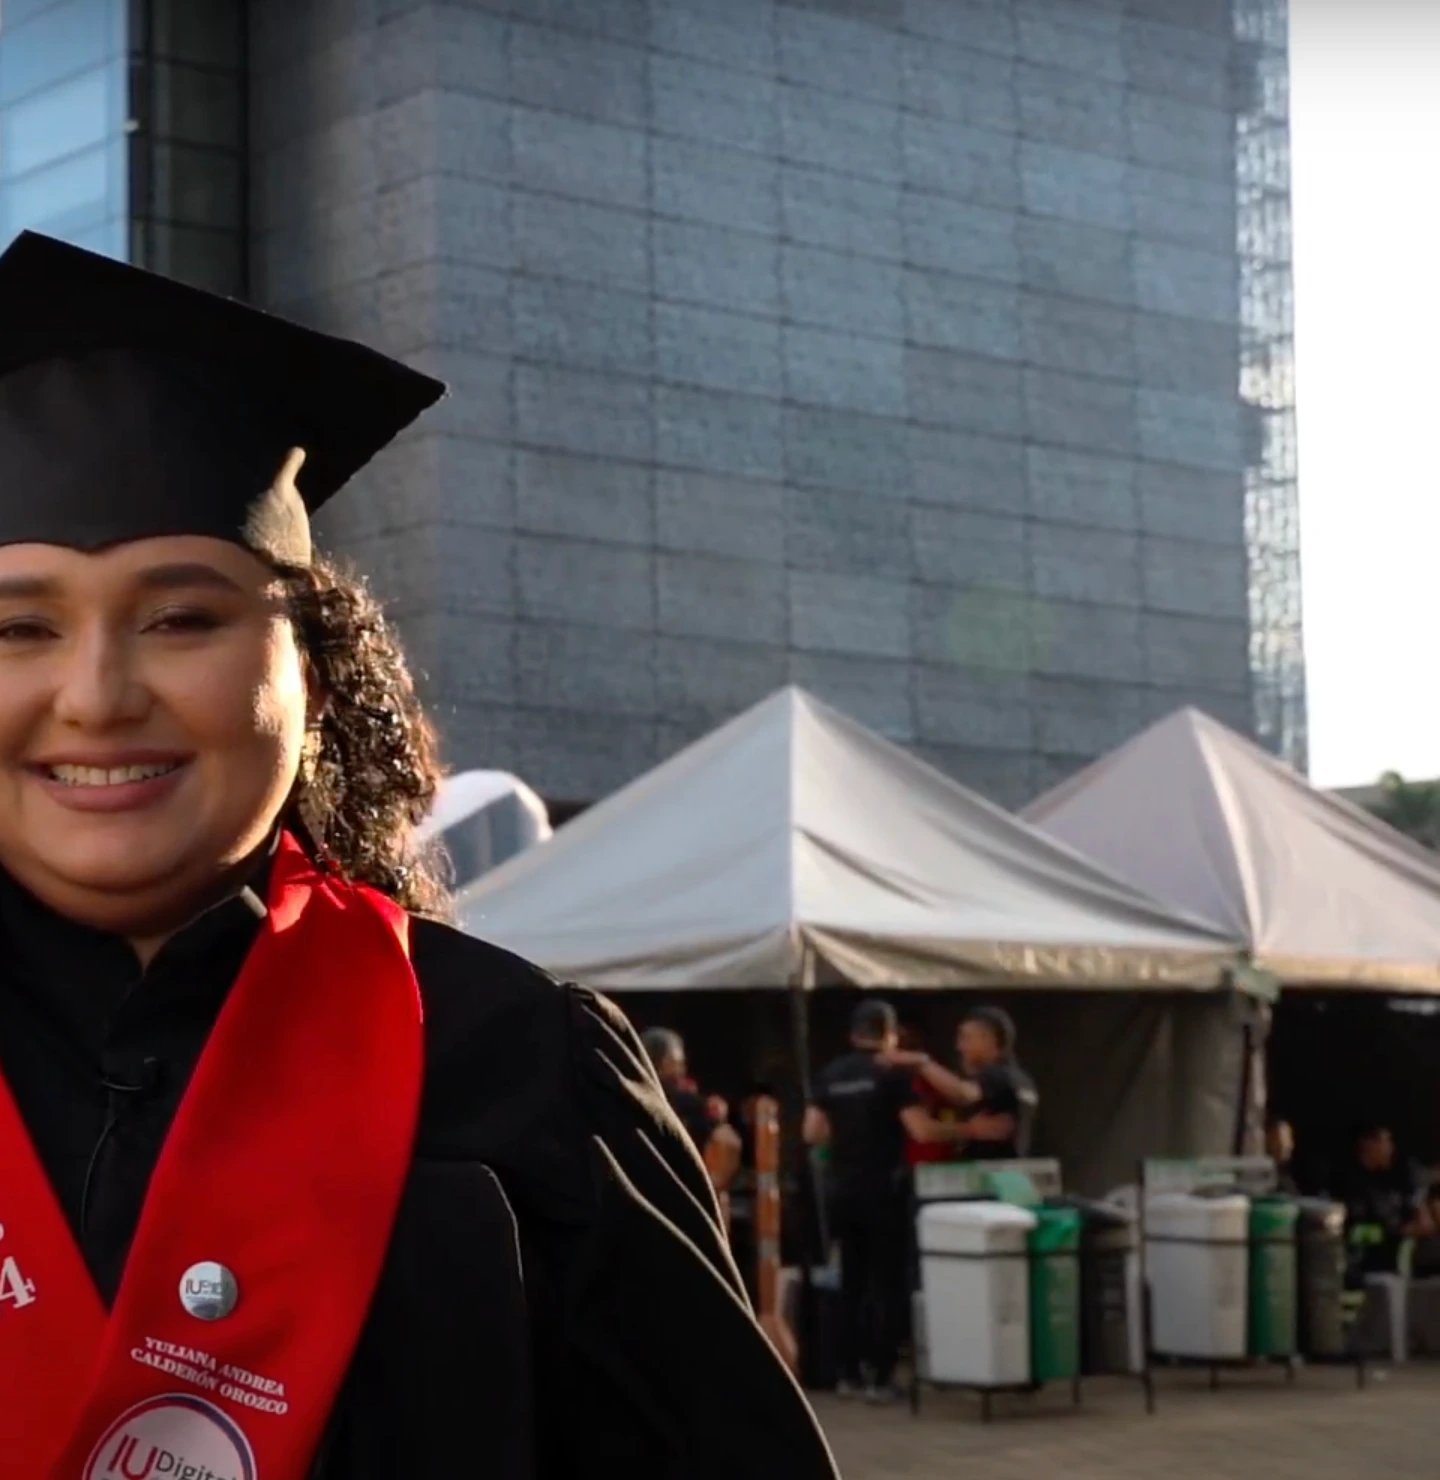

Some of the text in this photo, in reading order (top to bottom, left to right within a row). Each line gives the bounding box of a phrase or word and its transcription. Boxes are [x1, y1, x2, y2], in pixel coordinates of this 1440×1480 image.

[130, 1347, 288, 1415] CALDERÓN OROZCO
[145, 1336, 284, 1396] YULIANA ANDREA
